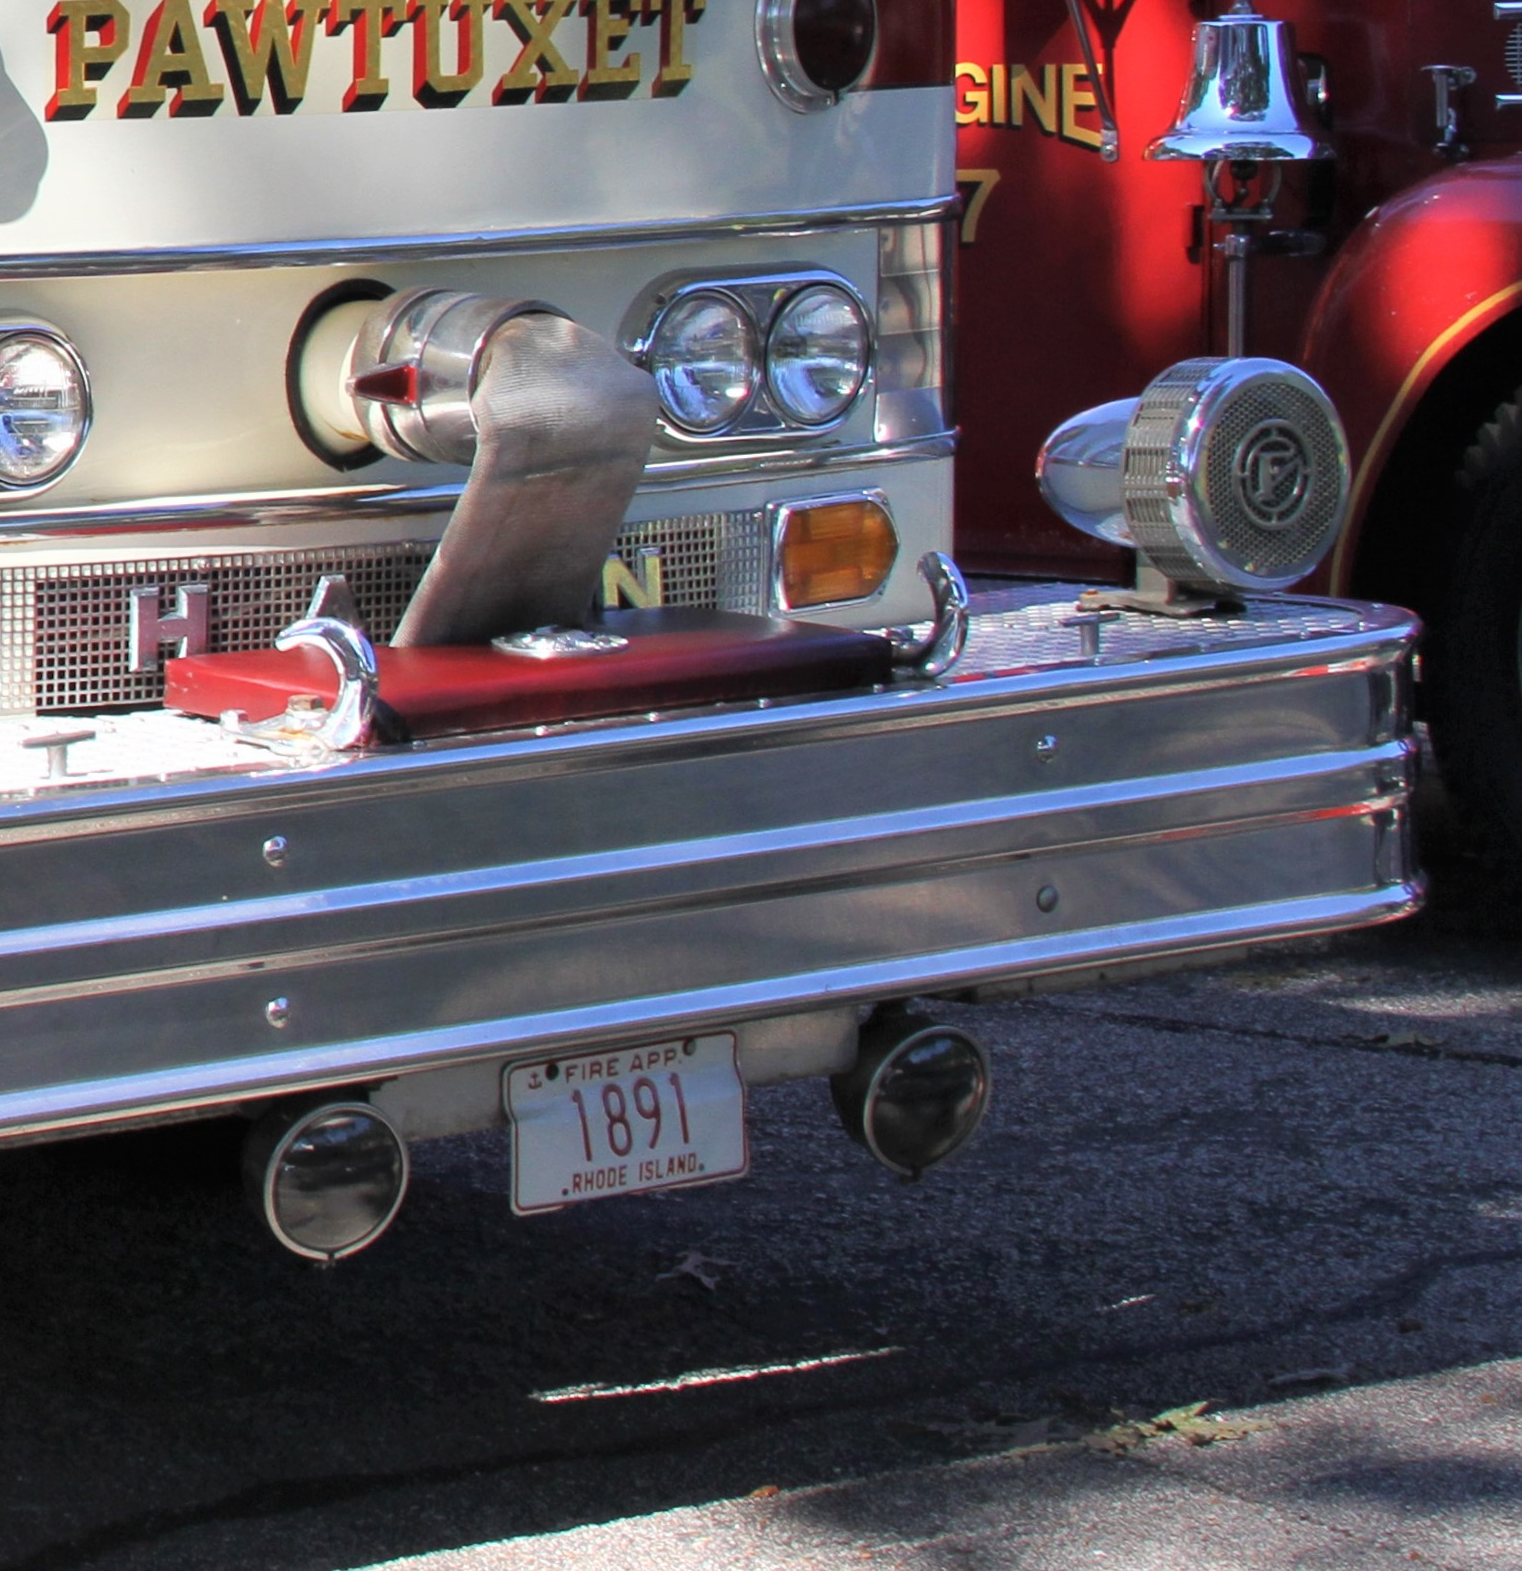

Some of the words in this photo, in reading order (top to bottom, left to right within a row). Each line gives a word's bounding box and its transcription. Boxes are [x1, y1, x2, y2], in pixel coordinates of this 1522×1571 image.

[564, 1057, 621, 1084] FIRE
[628, 1048, 683, 1073] APP.
[571, 1071, 690, 1162] 1891
[572, 1165, 628, 1194] RHODE
[638, 1152, 698, 1183] ISLAND
